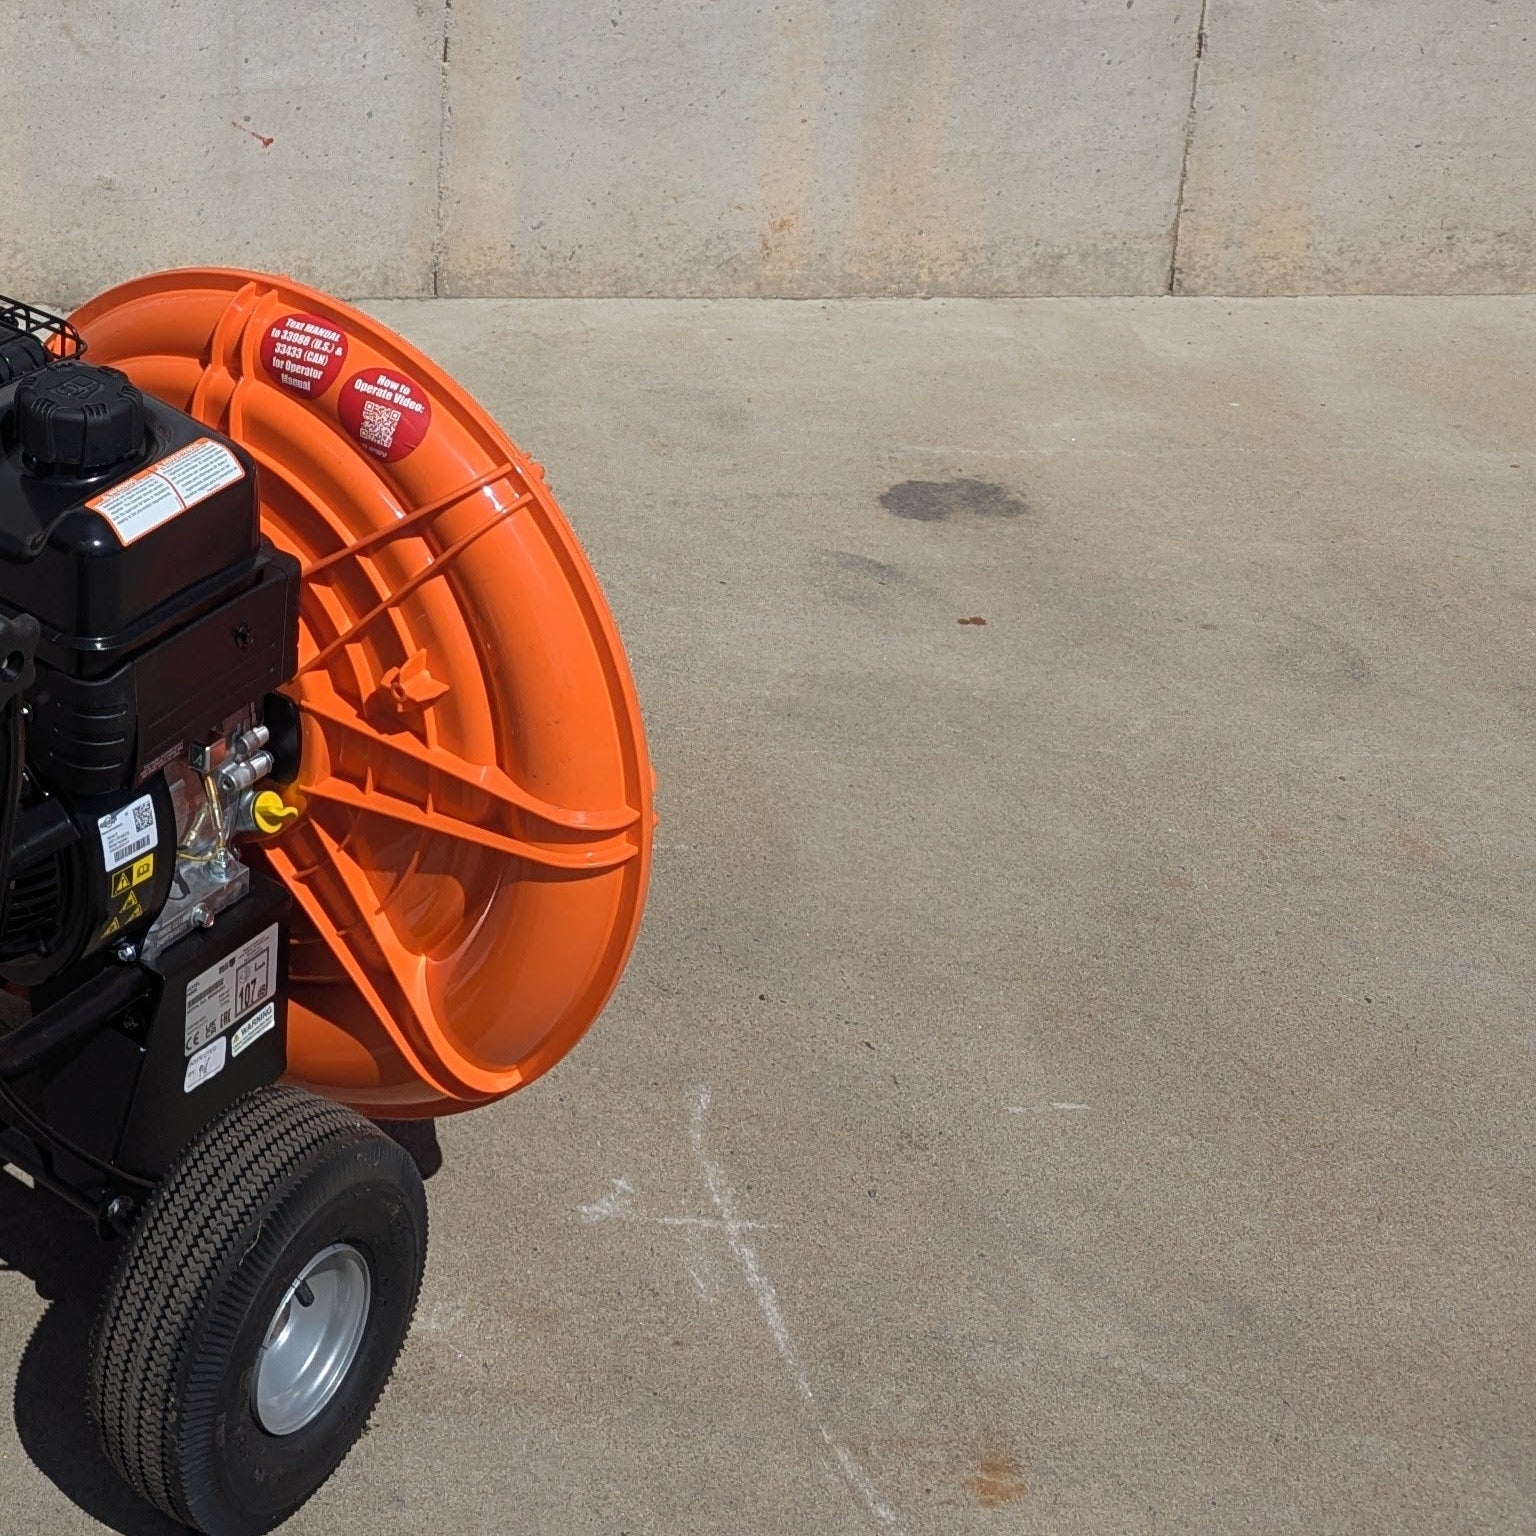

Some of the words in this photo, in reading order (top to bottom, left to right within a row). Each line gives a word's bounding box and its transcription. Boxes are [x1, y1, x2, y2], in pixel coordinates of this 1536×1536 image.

[271, 327, 281, 338] to
[335, 346, 343, 356] &
[304, 323, 341, 342] MANUAL
[275, 342, 303, 359] 33433
[303, 350, 329, 366] (CAN)
[272, 356, 285, 368] for
[285, 359, 323, 380] Operator
[281, 373, 311, 391] Manual
[376, 374, 400, 390] How
[399, 384, 411, 395] to
[354, 378, 393, 400] Operate
[393, 392, 425, 414] Video:
[239, 978, 256, 1011] 107
[240, 1005, 272, 1036] WARNING
[185, 1031, 200, 1051] CE
